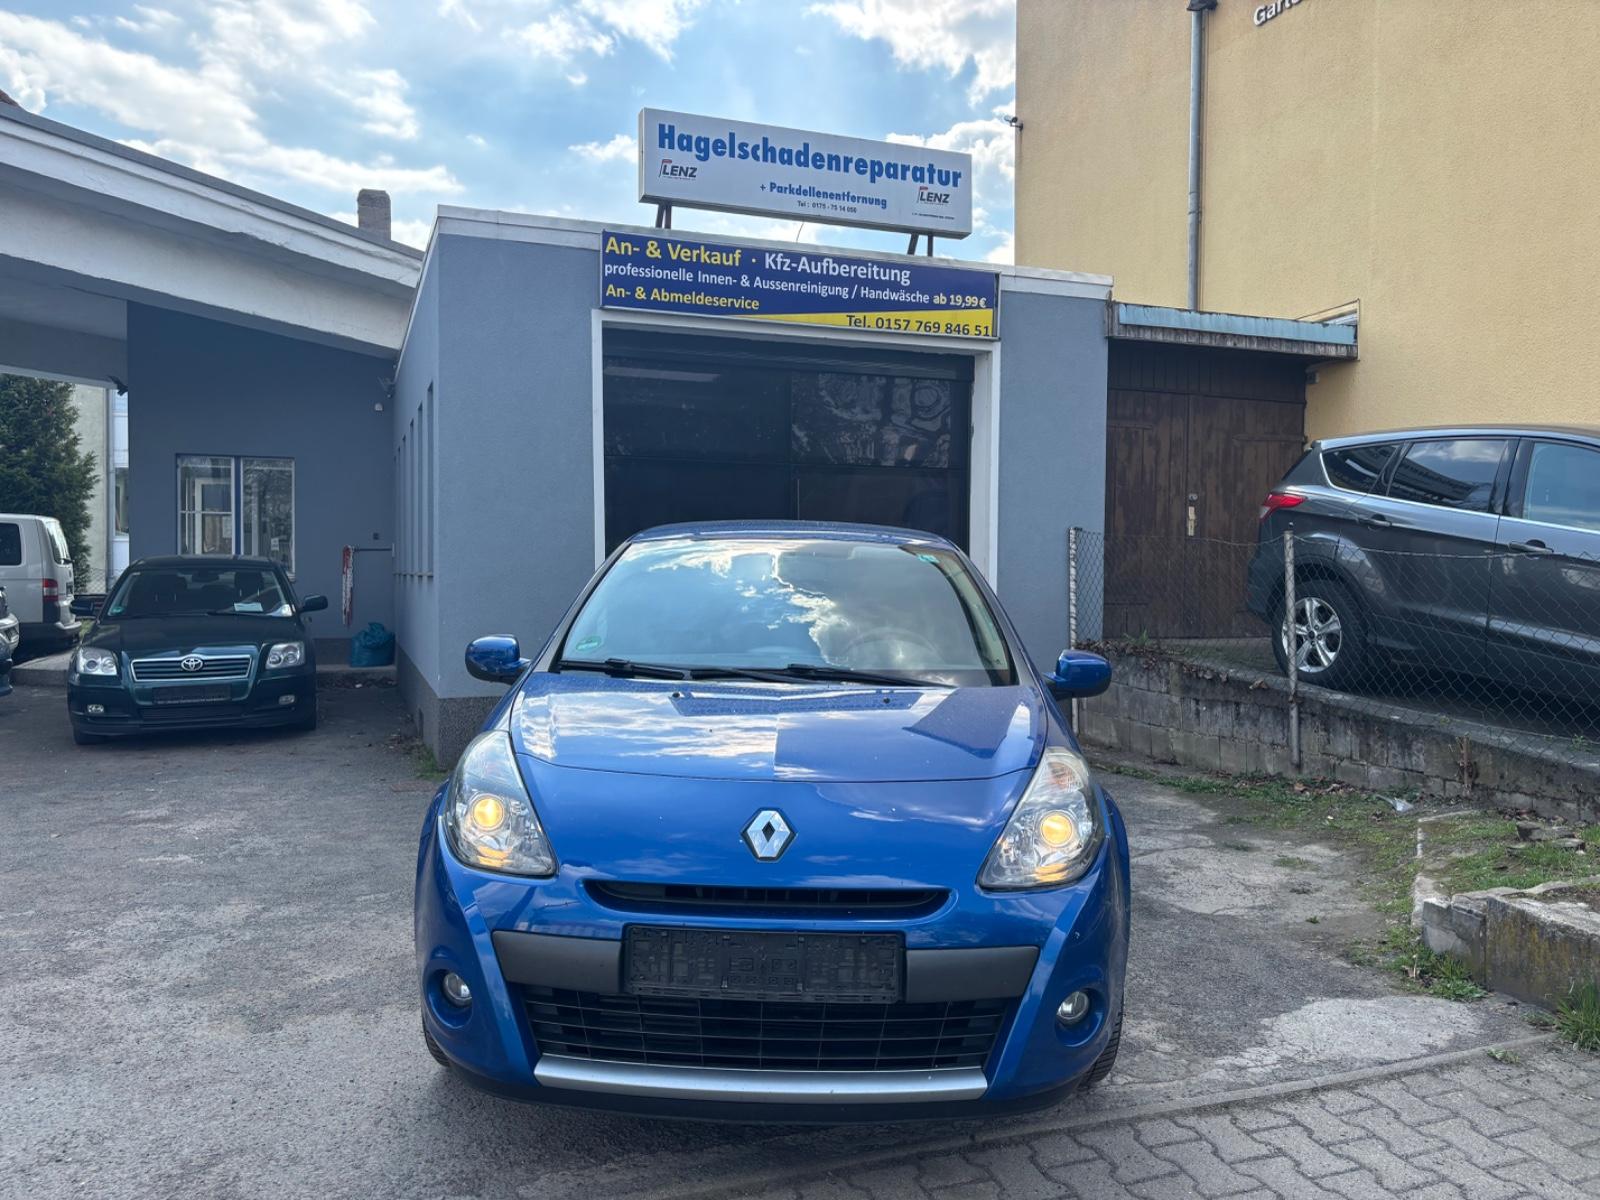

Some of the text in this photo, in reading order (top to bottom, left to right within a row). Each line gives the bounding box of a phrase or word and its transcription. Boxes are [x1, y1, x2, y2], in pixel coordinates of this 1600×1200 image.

[658, 123, 962, 188] Hagelschadenreparatur
[662, 164, 698, 178] LENZ
[769, 182, 887, 209] Parkdellenentfernung
[919, 191, 950, 204] LENZ
[605, 236, 640, 256] An-
[646, 240, 662, 259] &
[667, 242, 742, 267] Verkauf
[764, 252, 911, 286] Kfz-Aufbereitung
[604, 262, 694, 282] professionelle
[698, 270, 737, 286] Innen-
[740, 275, 751, 288] &
[753, 276, 849, 299] Aussenreinigung
[860, 286, 930, 304] Handwäsche
[933, 292, 947, 305] ab
[606, 283, 760, 310] An- & Abmeldeservice
[846, 314, 990, 337] Tel. 0157 769 846 51
